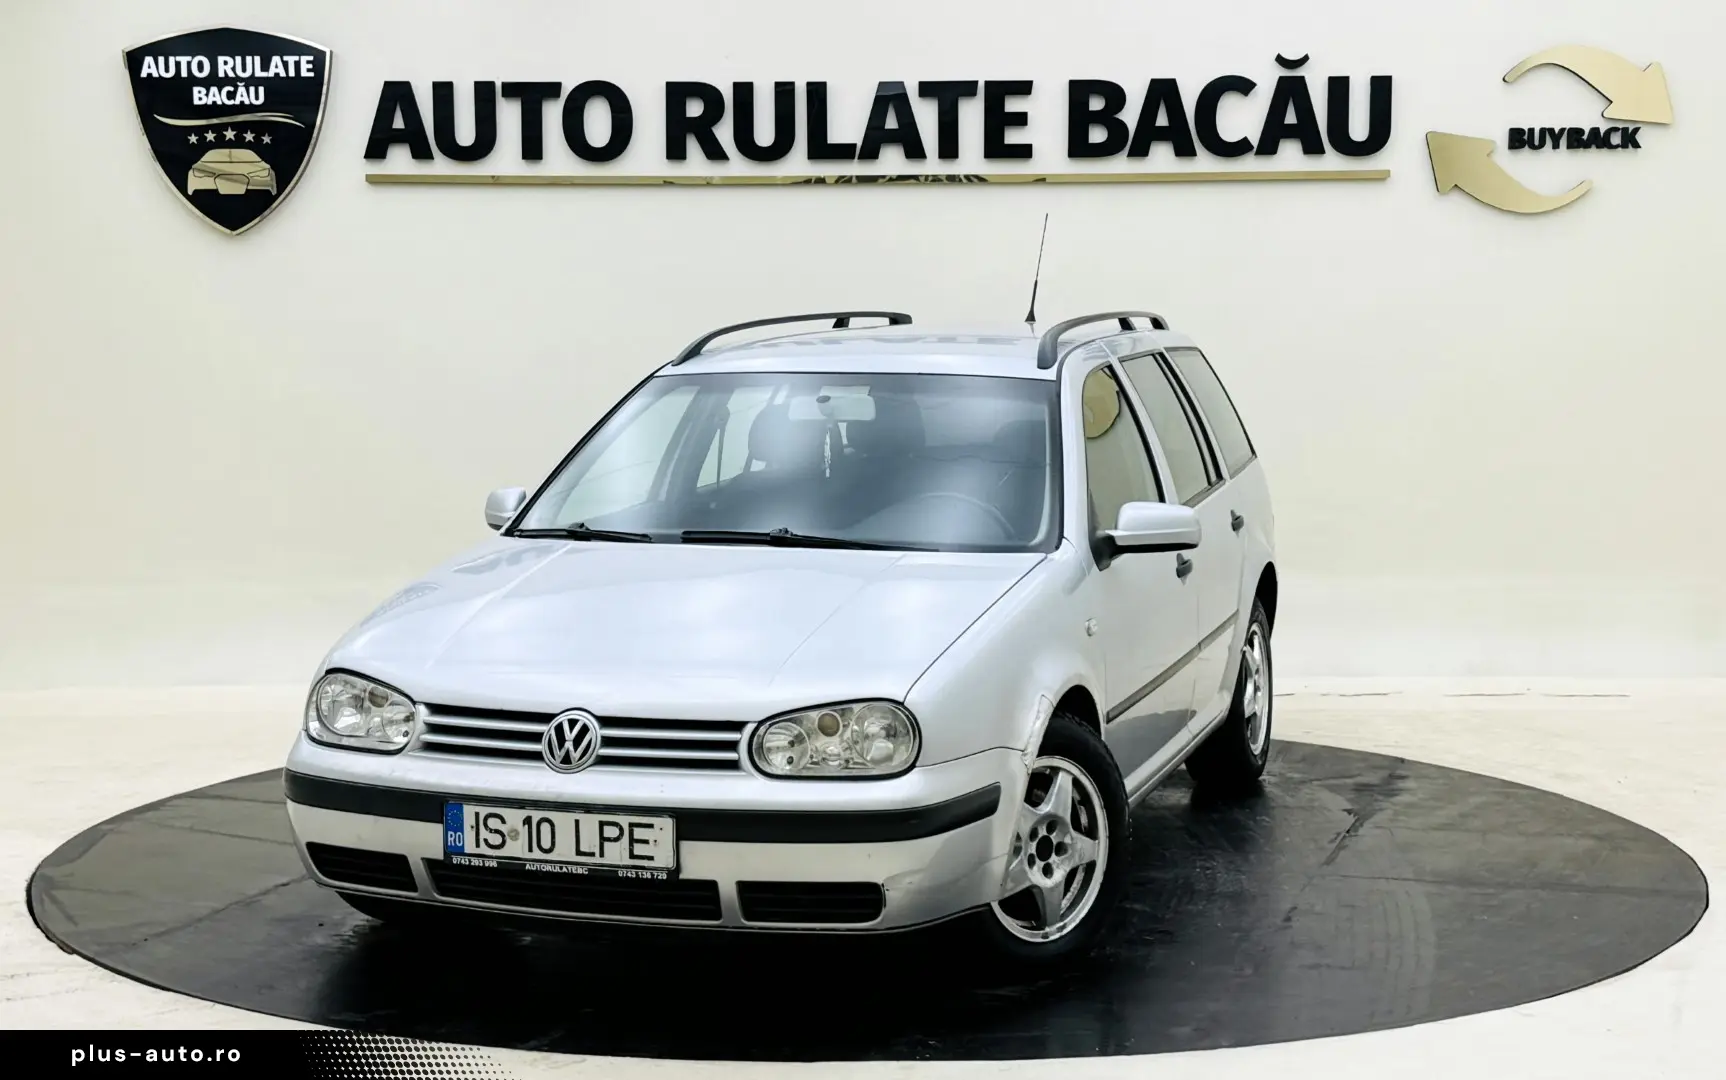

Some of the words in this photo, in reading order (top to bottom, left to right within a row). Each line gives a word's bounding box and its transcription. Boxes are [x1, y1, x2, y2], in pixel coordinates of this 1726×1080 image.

[140, 55, 211, 78] AUTO
[216, 55, 315, 78] RULATE
[192, 82, 265, 106] BACĂU
[363, 79, 634, 162] AUTO
[665, 80, 1034, 161] RULATE
[1067, 53, 1393, 158] BACĂU
[1507, 126, 1642, 150] BUYBACK
[447, 831, 463, 847] RO
[474, 811, 507, 850] IS
[522, 815, 556, 854] 10
[574, 818, 655, 861] LPE
[452, 857, 469, 865] 0743
[618, 870, 636, 878] 0743
